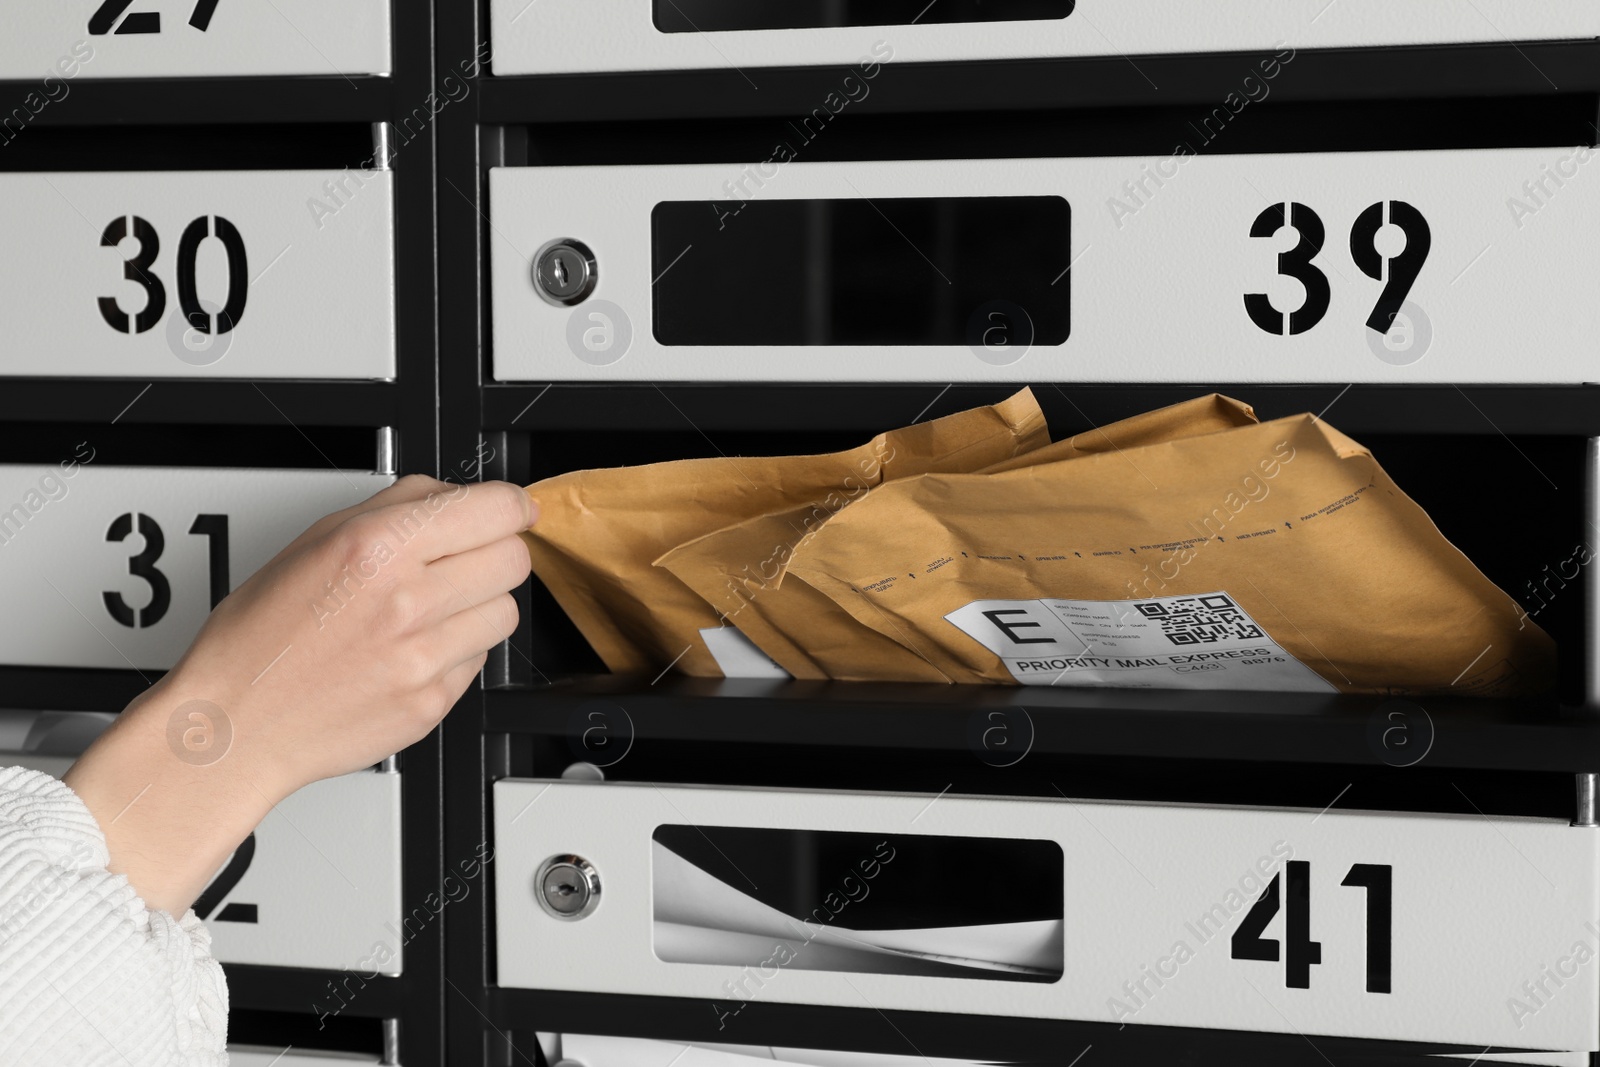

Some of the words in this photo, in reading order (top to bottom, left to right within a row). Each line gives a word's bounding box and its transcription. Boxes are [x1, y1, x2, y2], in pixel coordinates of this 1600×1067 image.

[98, 215, 249, 335] 30
[1244, 200, 1432, 336] 39
[103, 512, 230, 630] 31
[981, 609, 1057, 646] E
[1016, 657, 1111, 672] PRIORITY
[1114, 658, 1168, 668] MAIL
[1168, 648, 1272, 664] EXPRESS
[1231, 859, 1393, 994] 41
